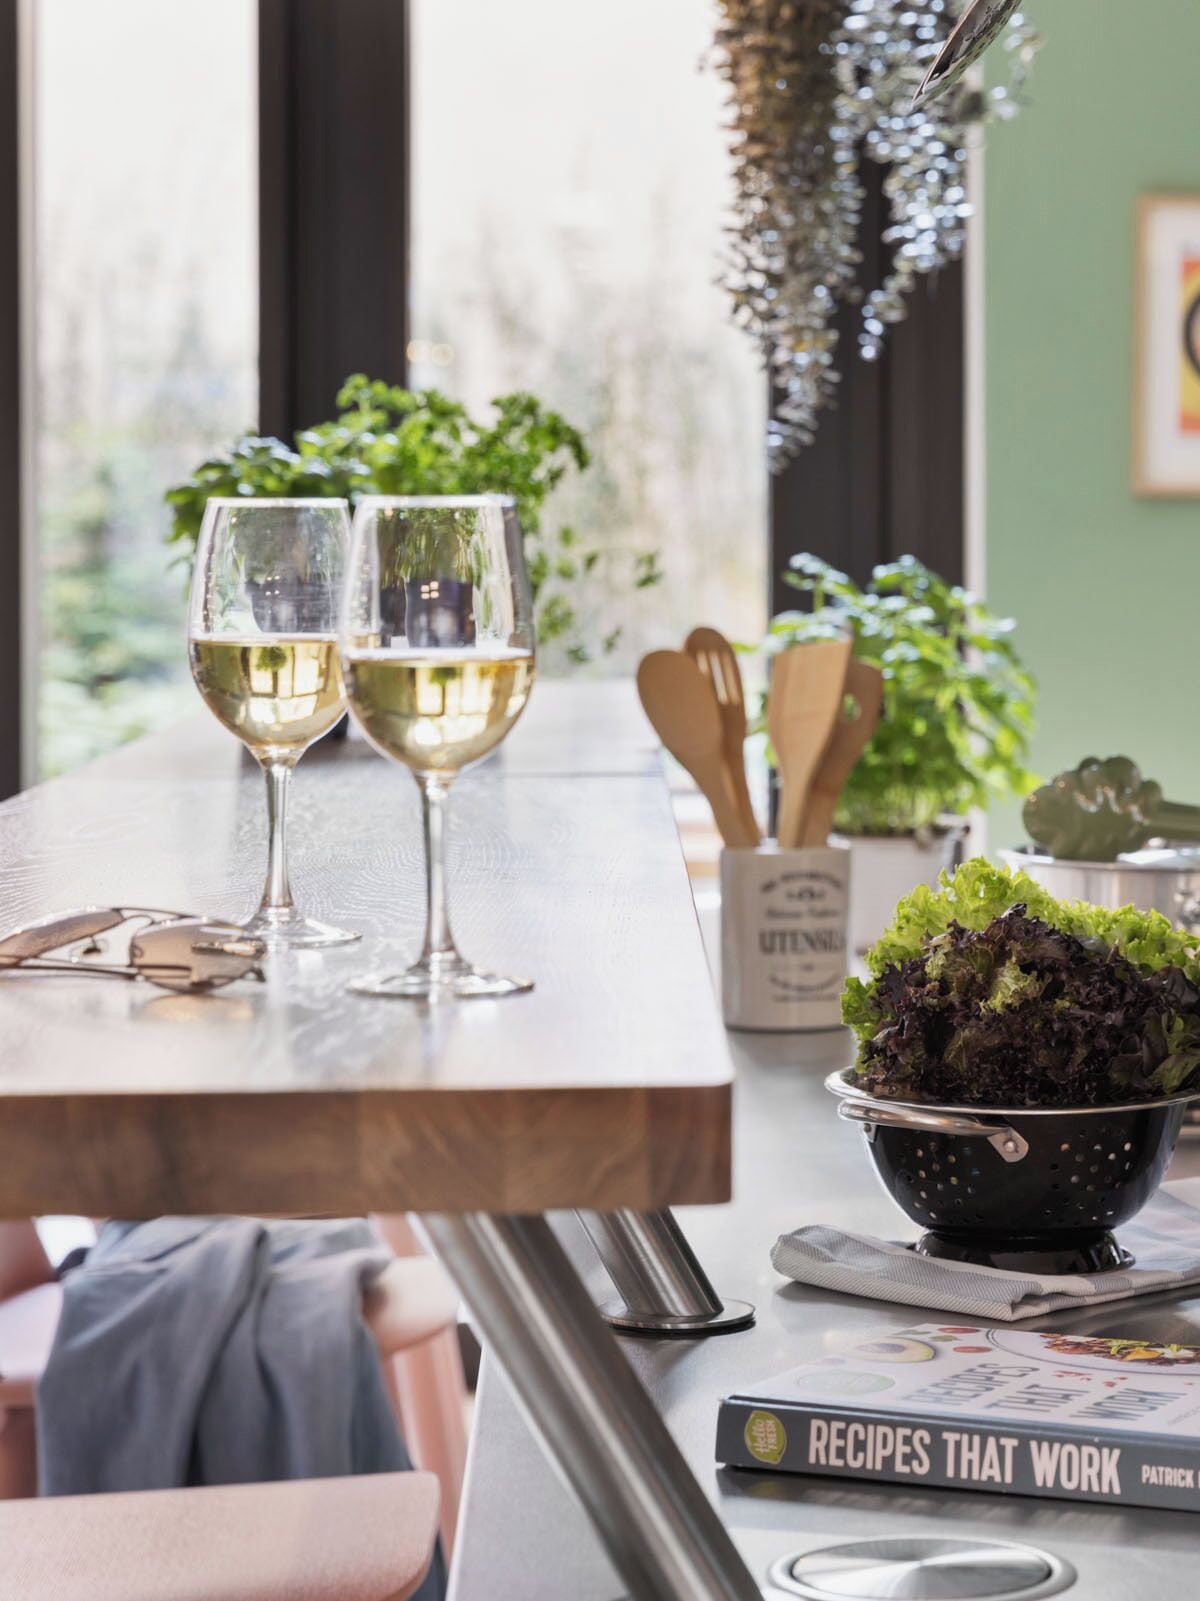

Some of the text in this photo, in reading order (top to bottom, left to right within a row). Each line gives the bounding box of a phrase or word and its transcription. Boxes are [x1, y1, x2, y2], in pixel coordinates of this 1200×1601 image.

[901, 1363, 1041, 1406] RECIPES
[984, 1384, 1090, 1413] THAT
[1069, 1387, 1188, 1421] WORK
[809, 1419, 931, 1476] RECIPES
[942, 1431, 1019, 1485] THAT
[1030, 1440, 1122, 1495] WORK
[1141, 1465, 1195, 1489] PATRICK
